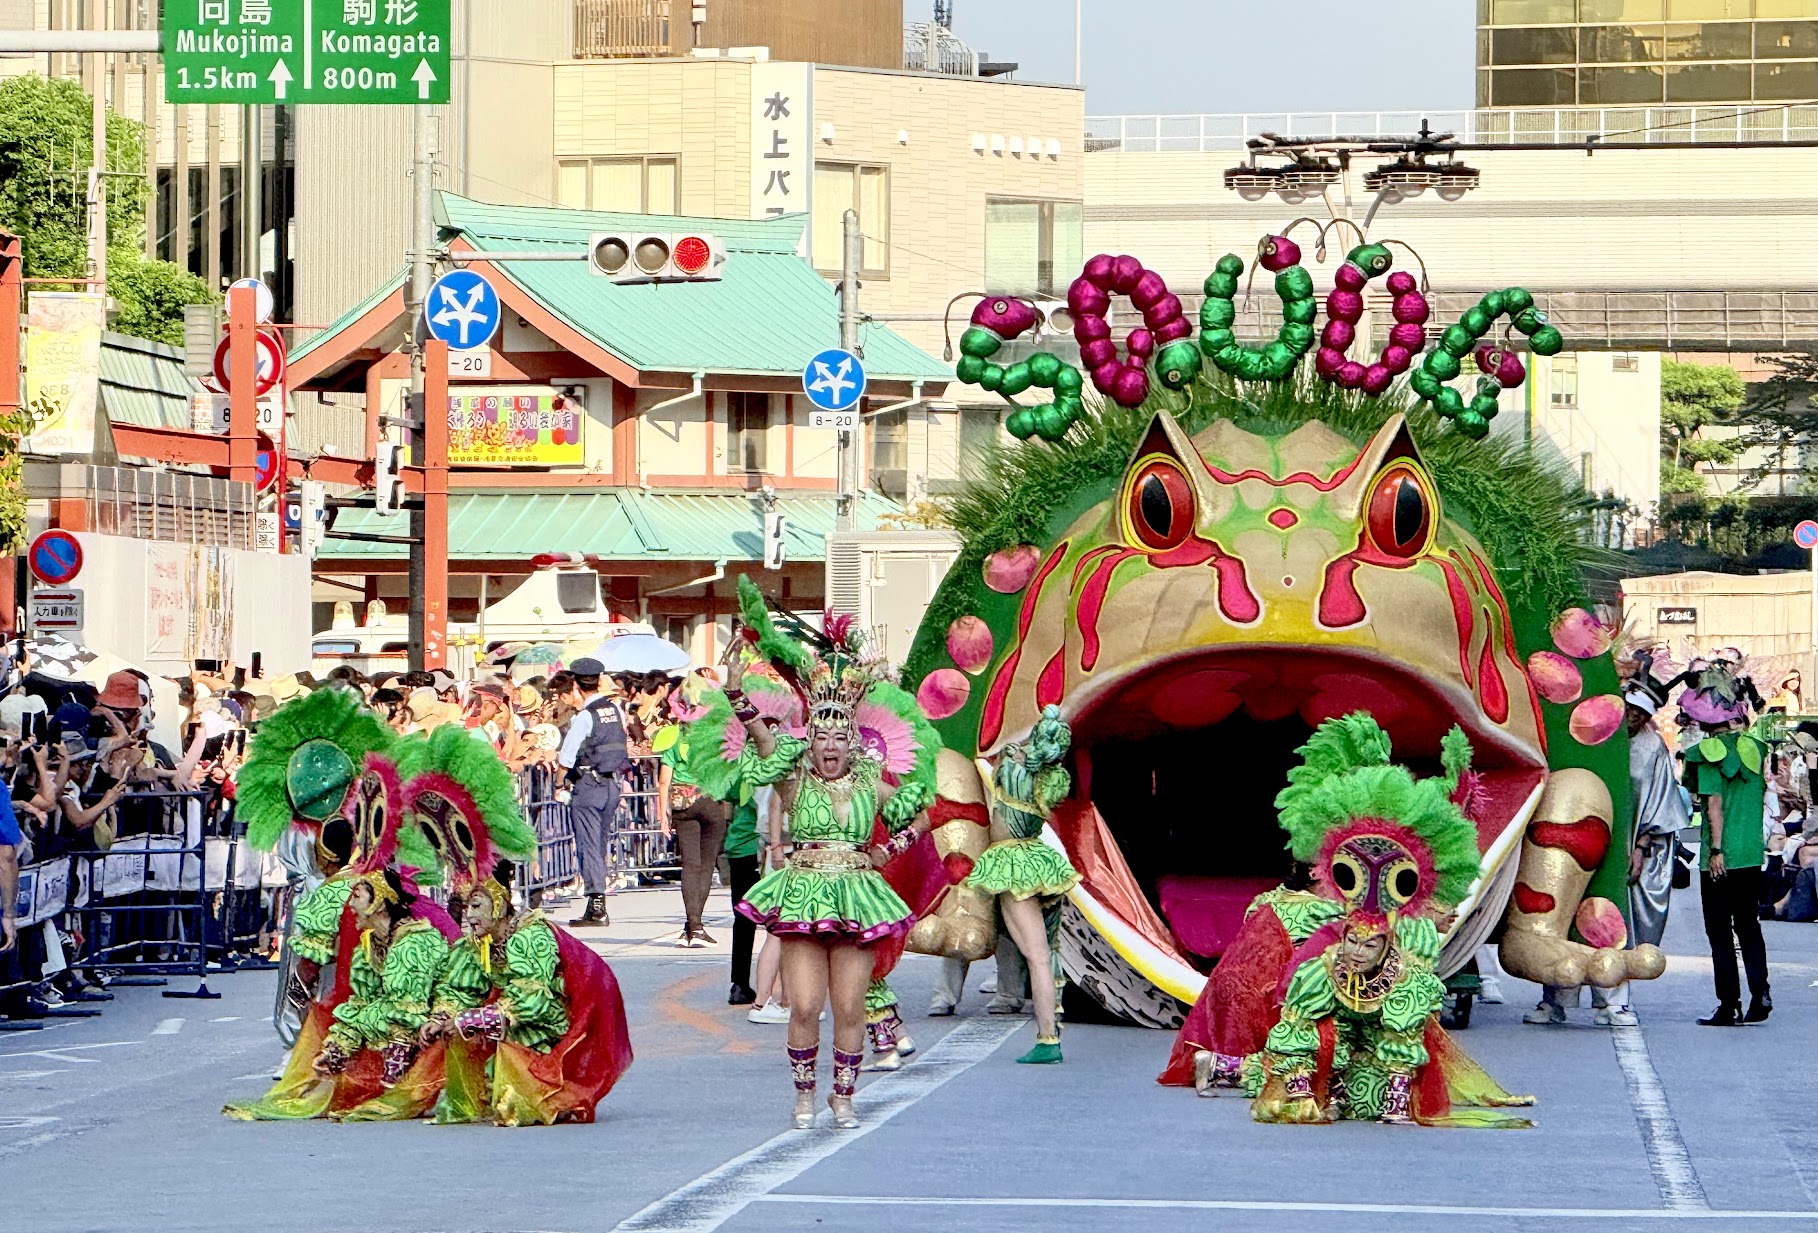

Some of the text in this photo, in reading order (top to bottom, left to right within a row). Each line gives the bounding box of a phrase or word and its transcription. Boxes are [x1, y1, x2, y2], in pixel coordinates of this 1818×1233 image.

[176, 28, 293, 58] Mukojima
[321, 29, 440, 58] Komagata
[177, 66, 257, 89] 1.5km
[323, 67, 397, 89] 800m
[763, 91, 791, 215] 水上バ
[451, 357, 483, 371] -20
[815, 416, 852, 426] 8-20
